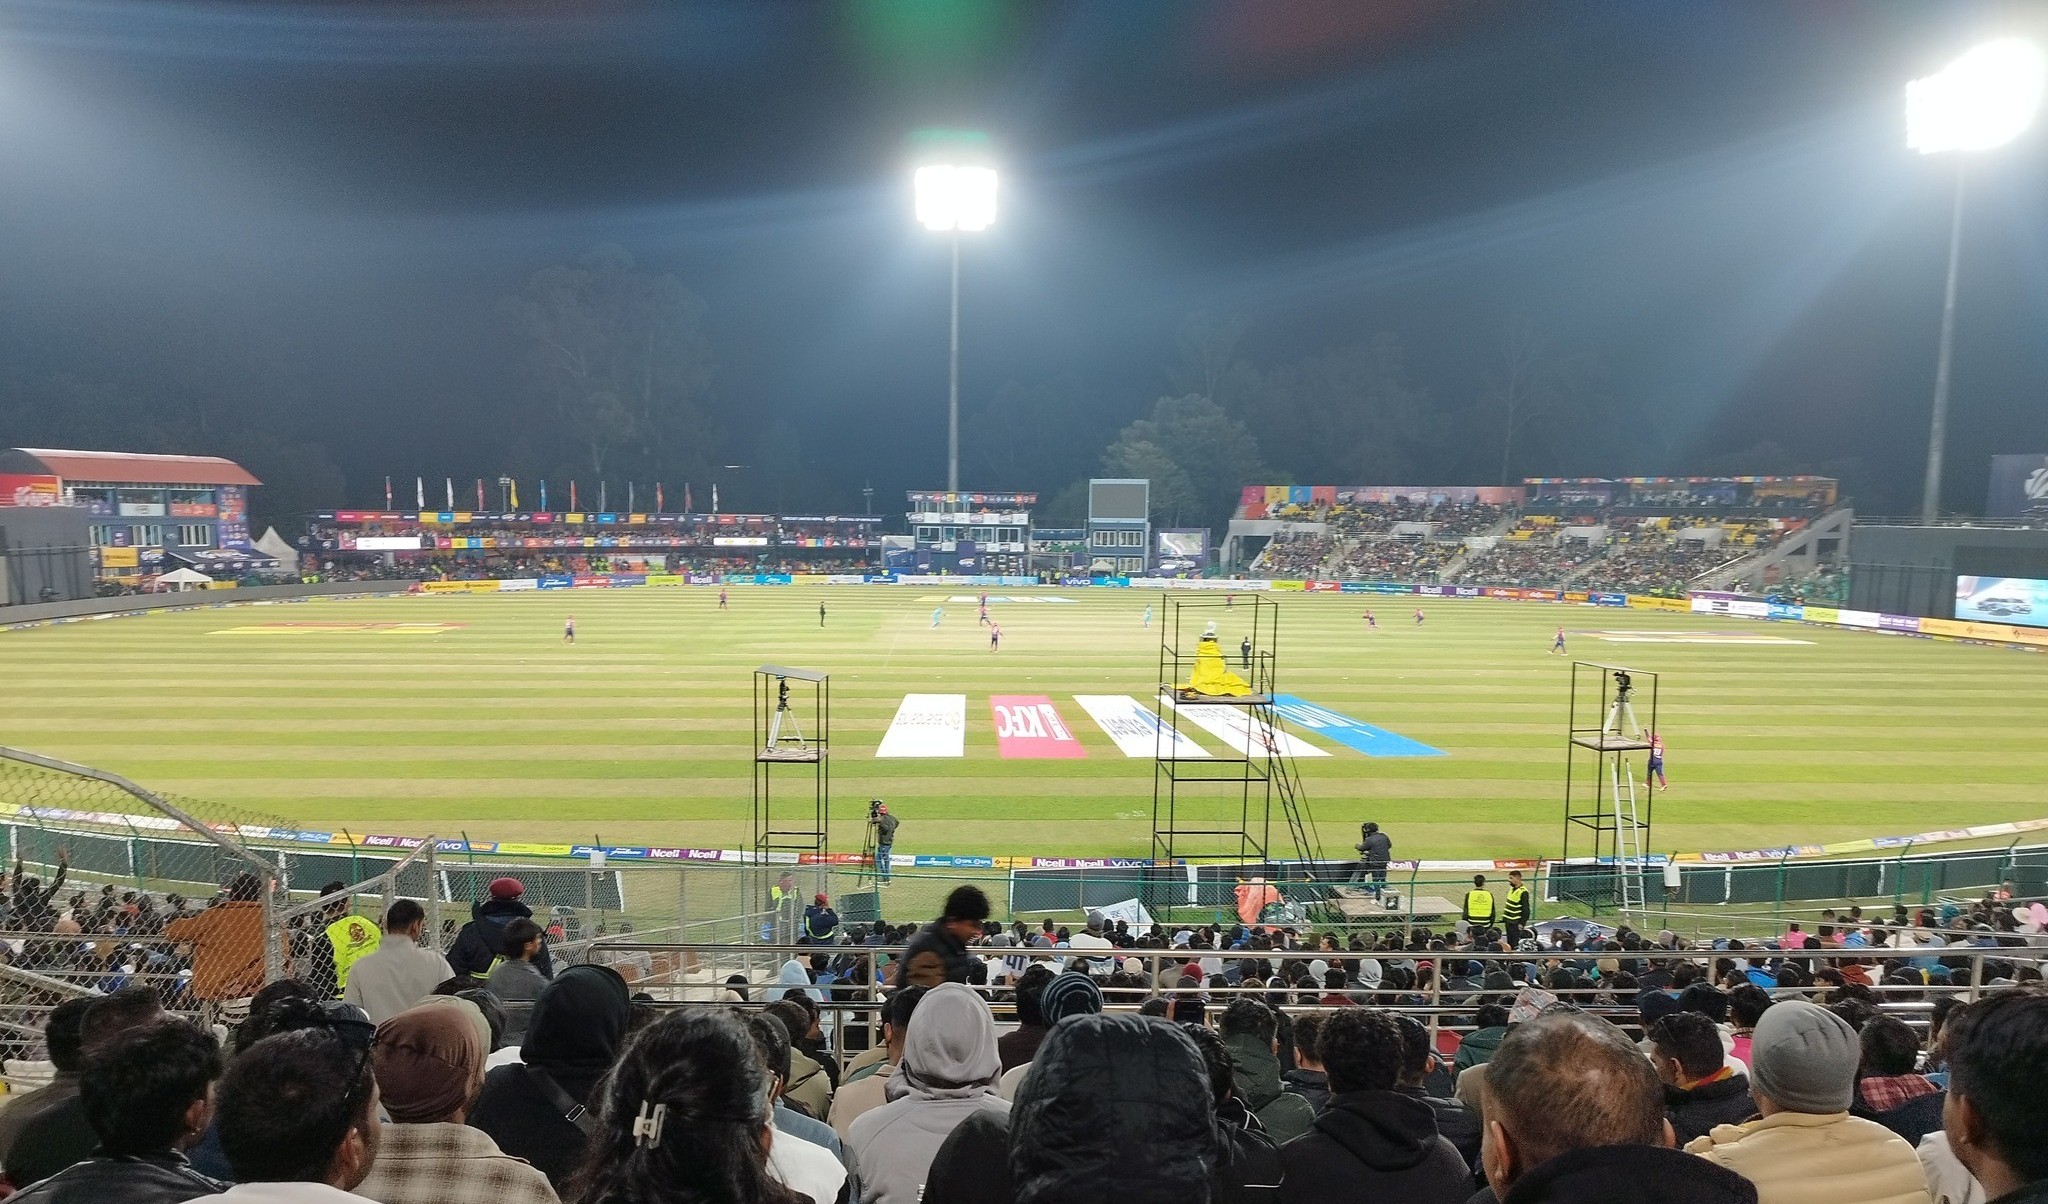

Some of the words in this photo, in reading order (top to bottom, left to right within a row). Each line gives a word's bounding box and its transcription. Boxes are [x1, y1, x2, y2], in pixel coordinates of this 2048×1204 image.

[690, 575, 713, 584] Ncell
[1065, 576, 1092, 585] vivo
[1419, 585, 1443, 594] Ncell
[1455, 587, 1479, 596] Ncell
[994, 705, 1049, 738] KFC
[366, 836, 394, 846] Ncell
[400, 837, 424, 848] Nce
[650, 848, 681, 858] Ncell
[688, 849, 718, 859] Ncell
[1036, 858, 1066, 867] Ncell
[1075, 859, 1104, 867] Ncell
